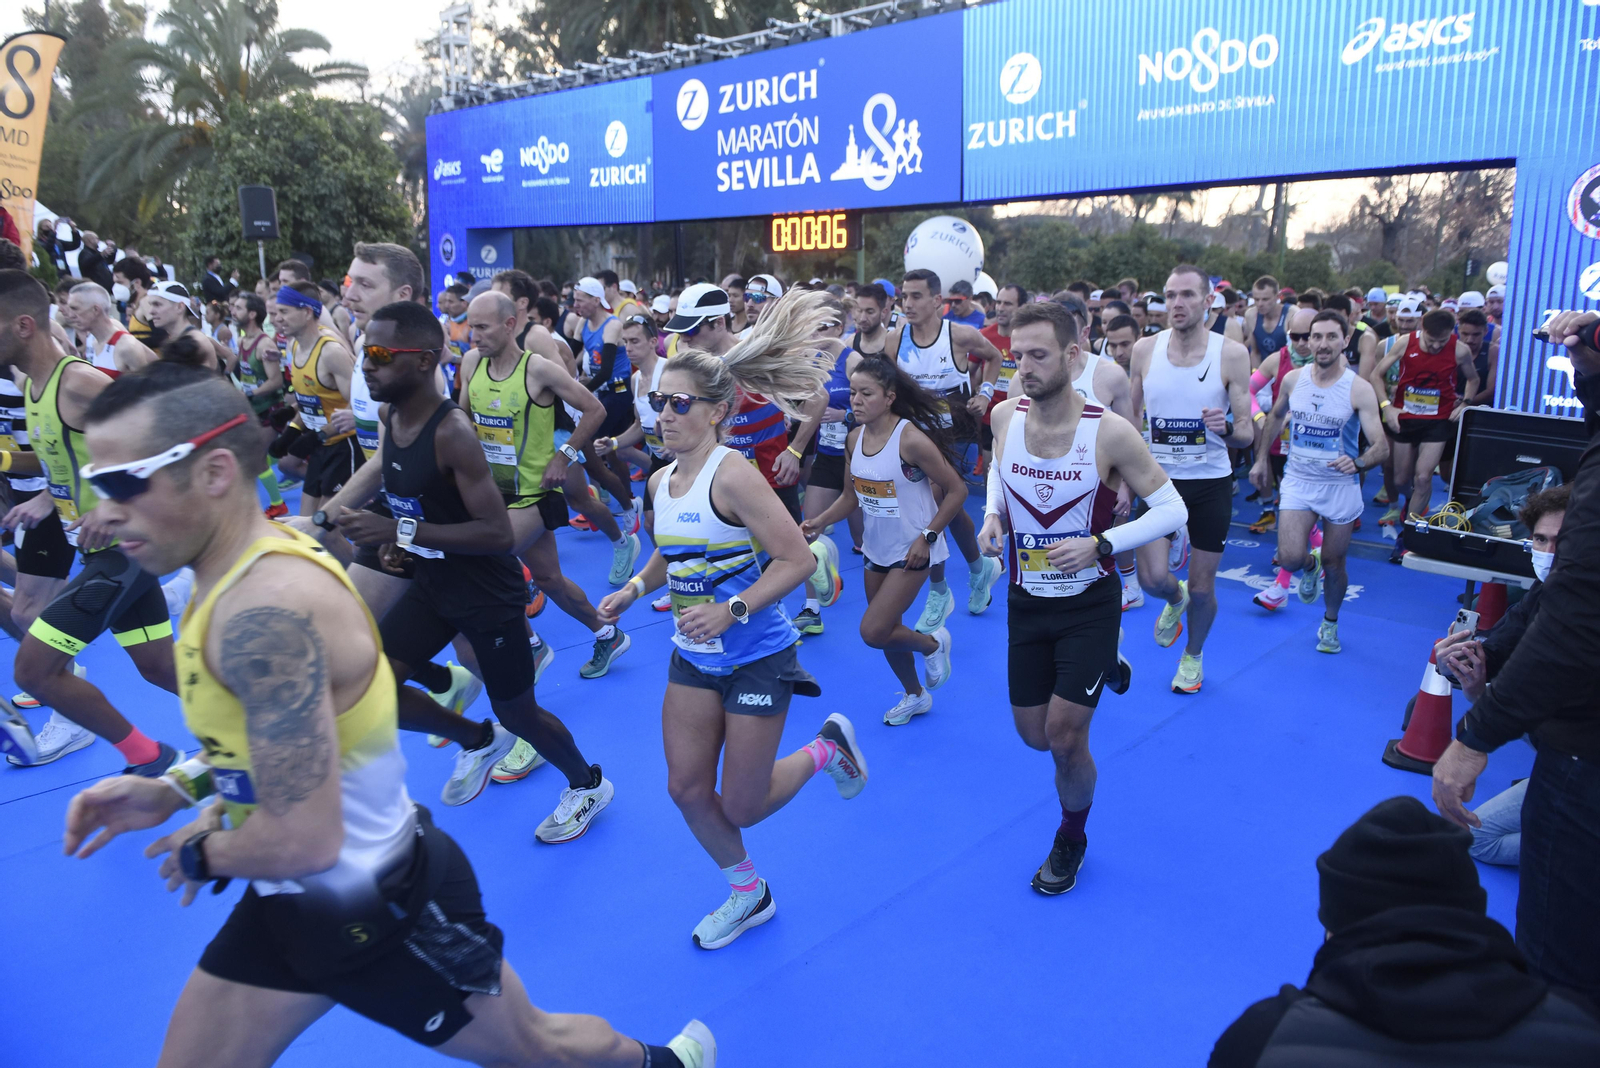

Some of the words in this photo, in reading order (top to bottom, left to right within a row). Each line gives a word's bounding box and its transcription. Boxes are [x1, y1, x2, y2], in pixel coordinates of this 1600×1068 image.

[1383, 12, 1476, 53] asics
[718, 69, 818, 114] ZURICH
[716, 112, 820, 157] MARATÓN
[967, 109, 1078, 150] ZURICH
[589, 164, 646, 187] ZURICH
[716, 152, 822, 193] SEVILLA
[930, 230, 974, 259] ZURICH
[481, 416, 508, 427] ZURICH
[1167, 421, 1199, 429] ZURICH
[1168, 435, 1188, 444] 2560
[1306, 428, 1336, 437] ZURICH
[1011, 463, 1082, 482] BORDEAUX
[863, 496, 879, 506] GRACE
[676, 512, 701, 524] HOKA
[670, 578, 704, 593] ZURICH
[1041, 573, 1077, 581] FLORENT
[737, 692, 773, 707] HOKA
[574, 797, 596, 823] FILA
